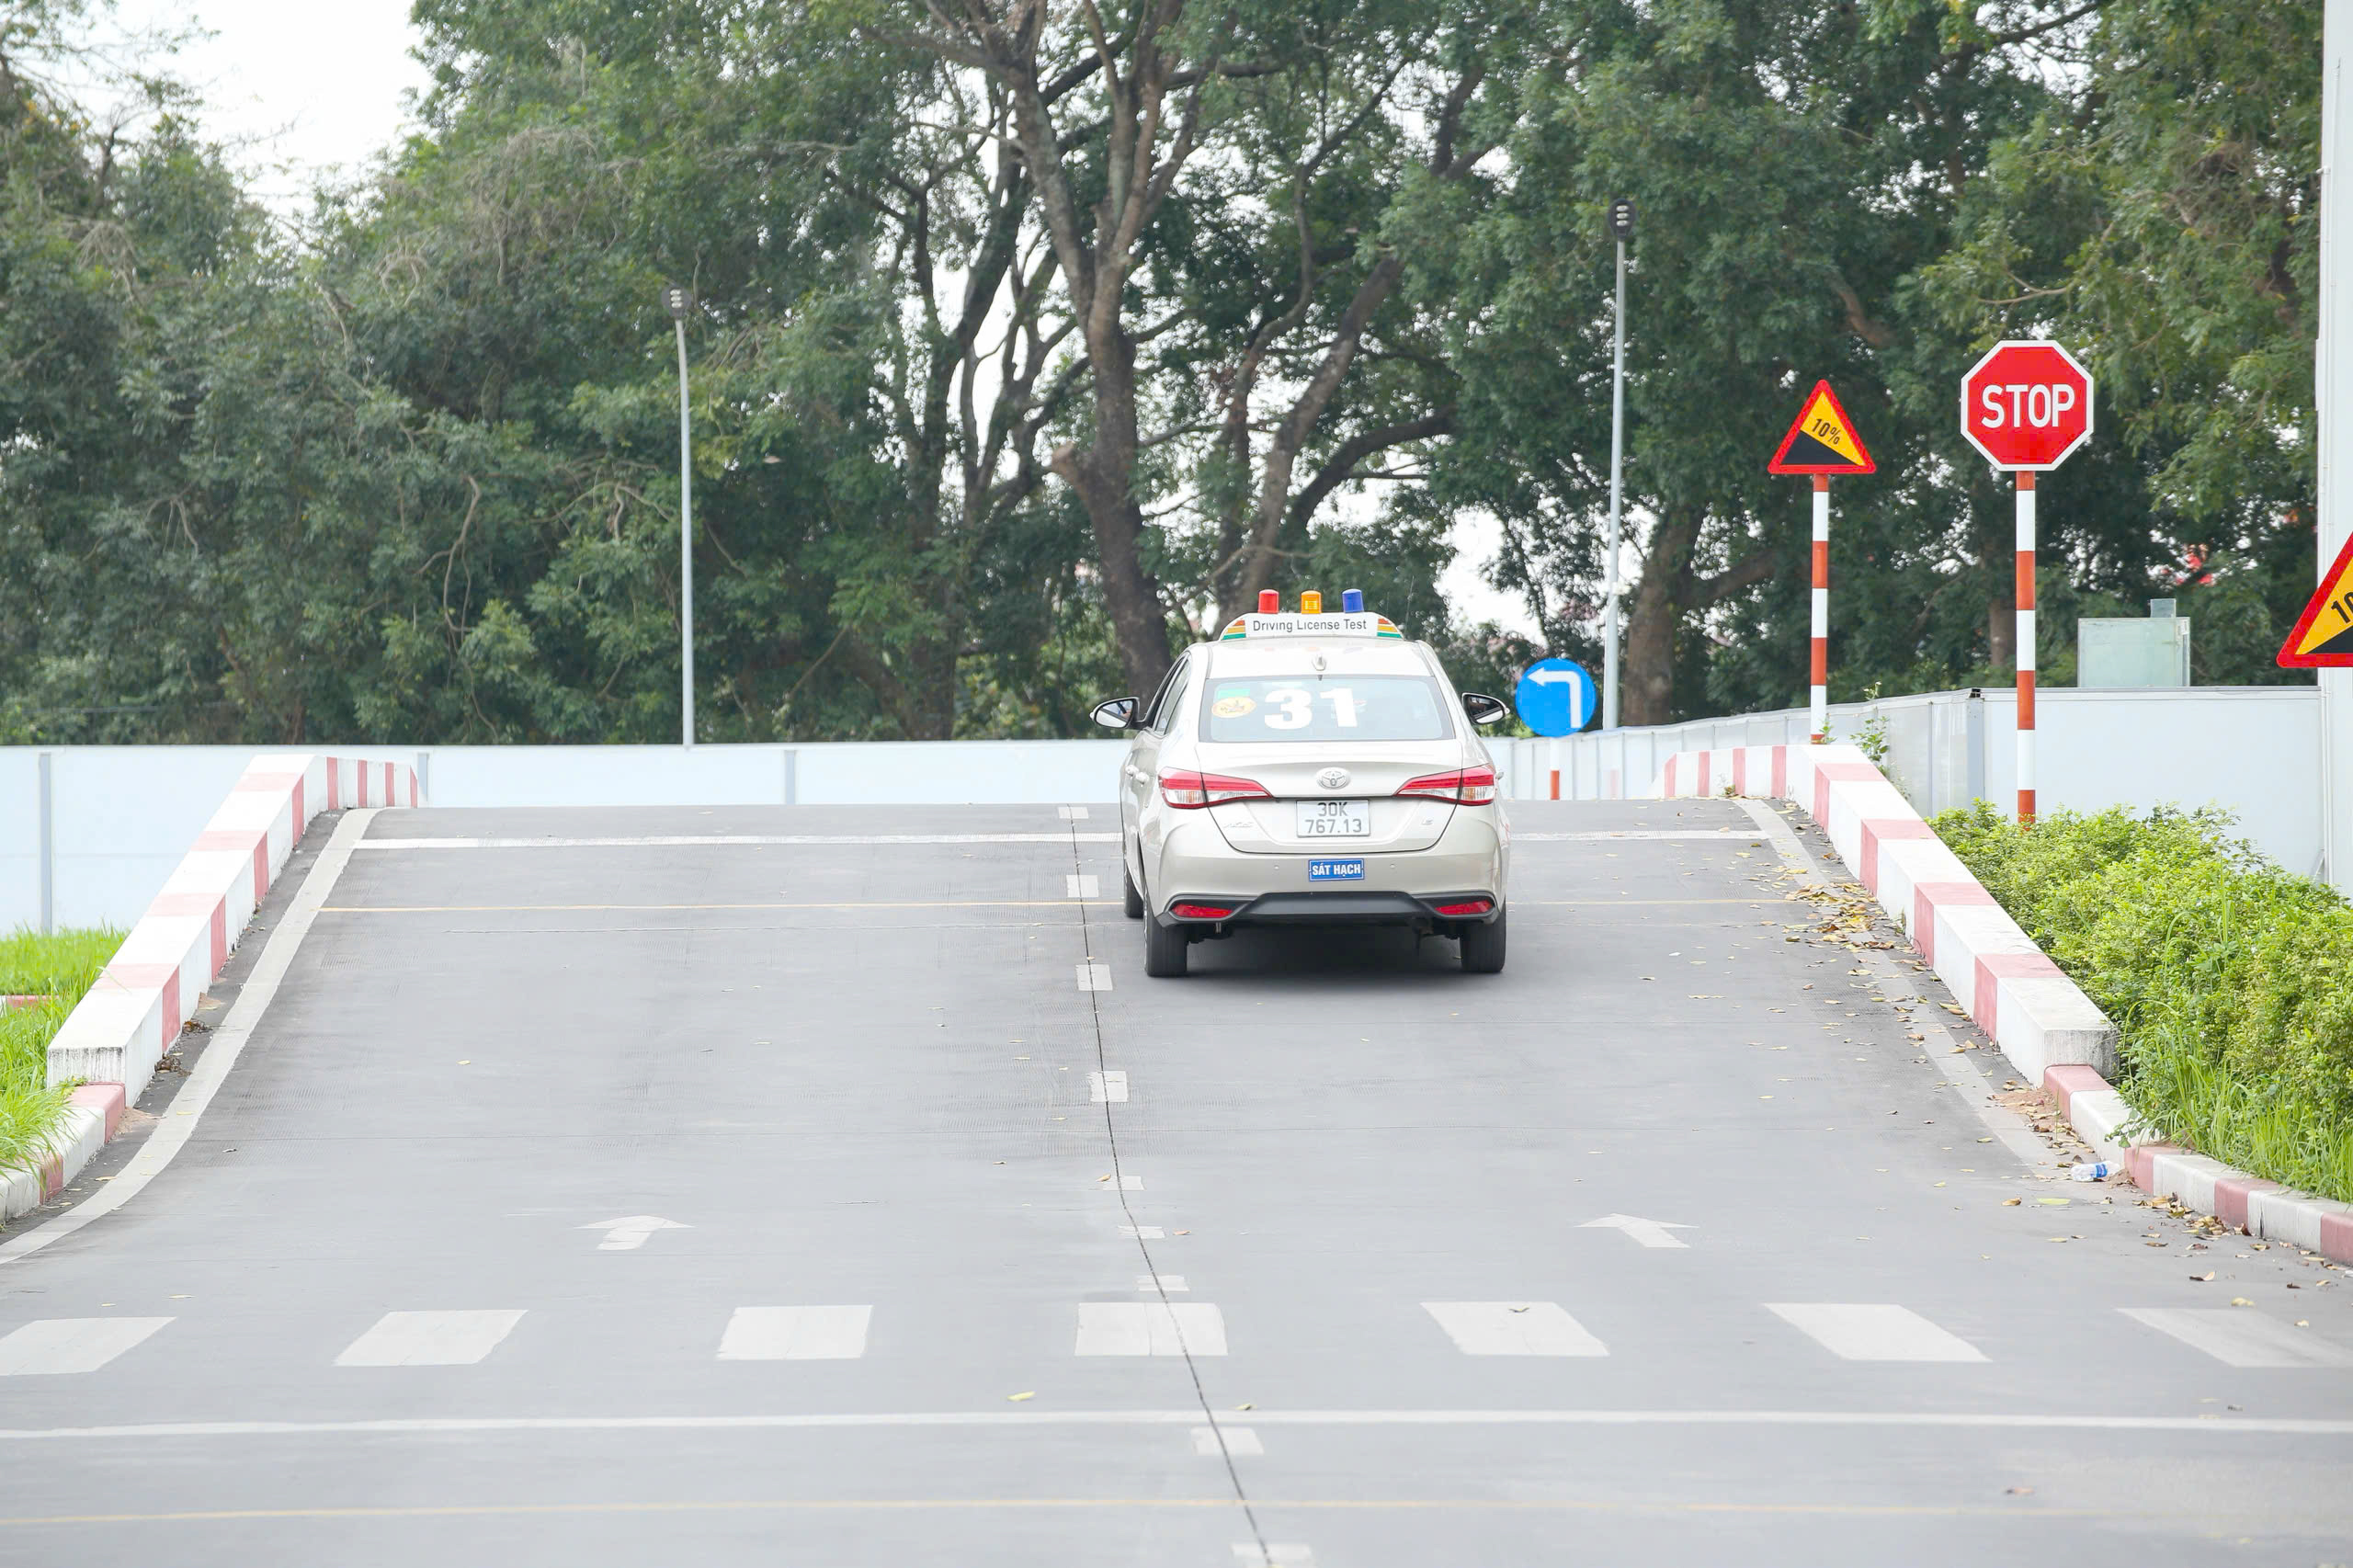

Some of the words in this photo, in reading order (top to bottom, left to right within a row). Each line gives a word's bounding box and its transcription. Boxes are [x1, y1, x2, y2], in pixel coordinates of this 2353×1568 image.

[1981, 383, 2075, 428] STOP
[1812, 418, 1842, 445] 10%
[1253, 619, 1293, 633] Driving
[1297, 619, 1340, 631] License
[1343, 619, 1367, 630] Test
[1264, 687, 1358, 730] 31
[1317, 801, 1348, 817] 30K
[1304, 818, 1362, 834] 767.13
[1312, 863, 1331, 876] SÁT
[1333, 863, 1361, 877] HẠCH
